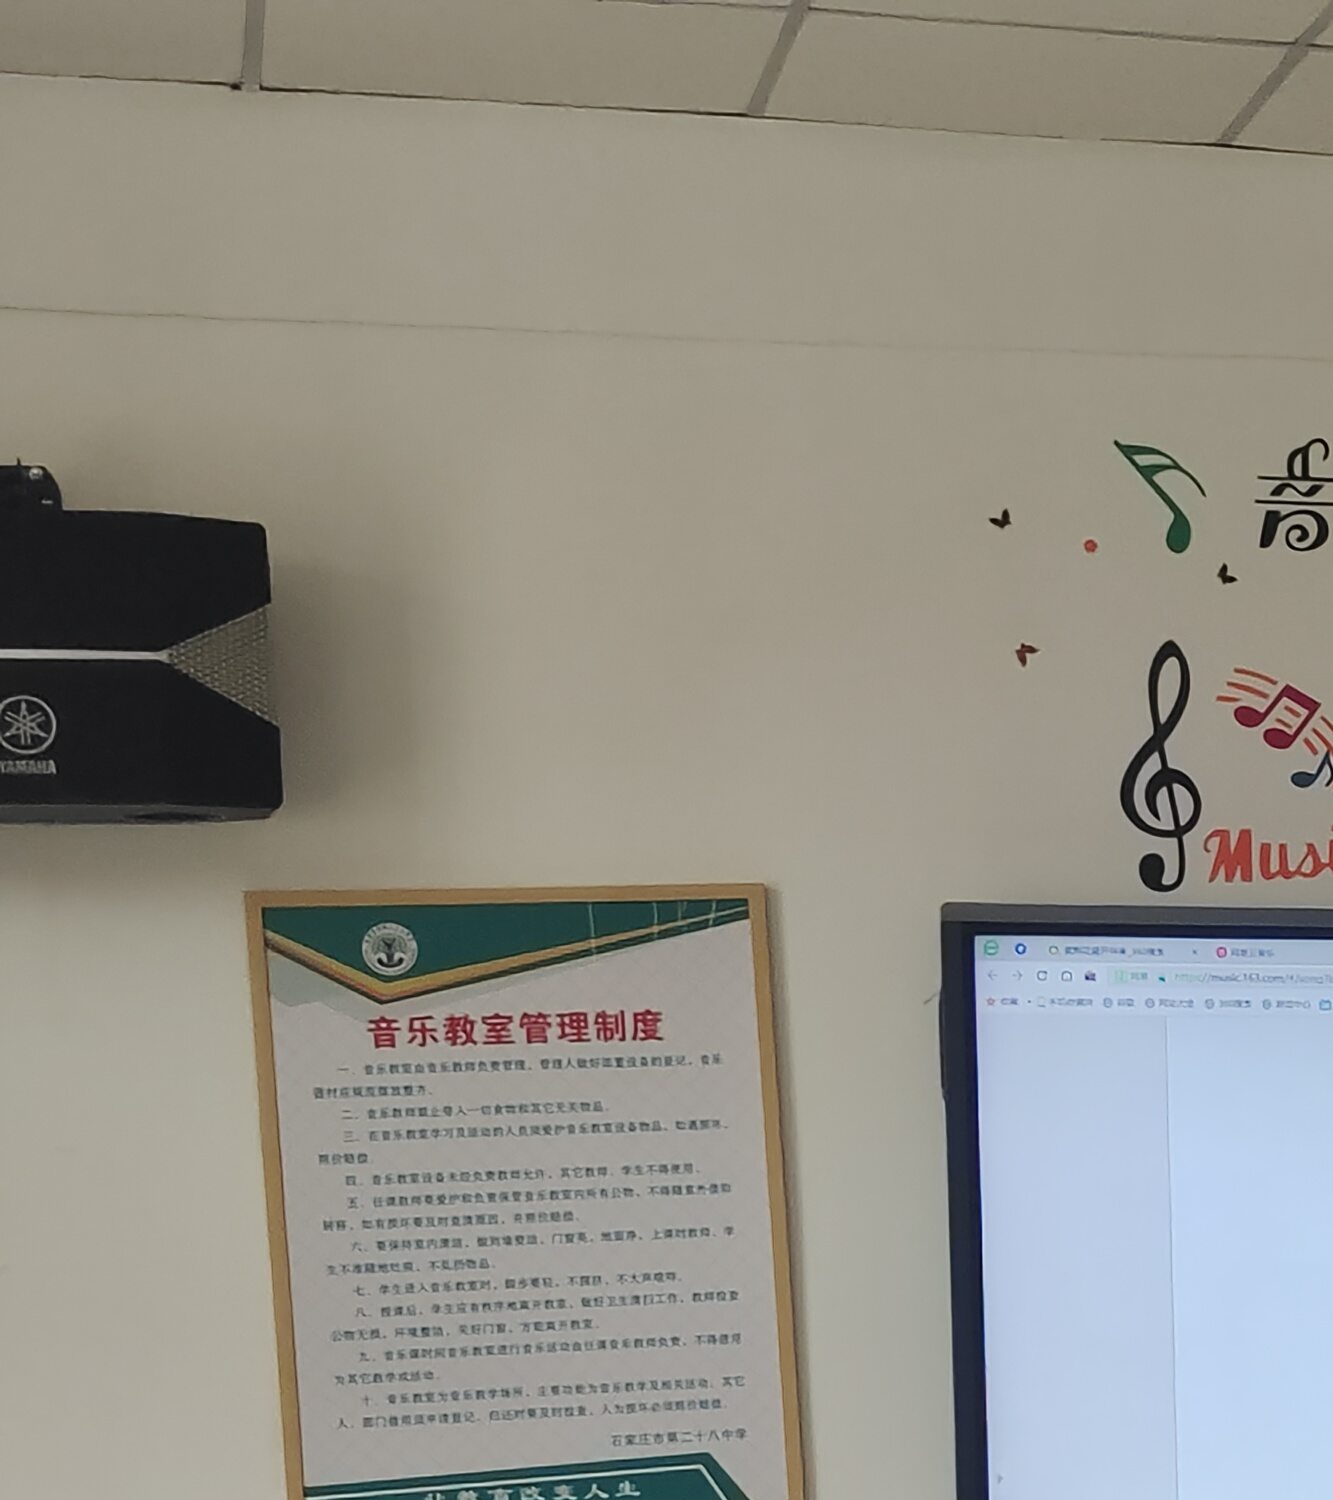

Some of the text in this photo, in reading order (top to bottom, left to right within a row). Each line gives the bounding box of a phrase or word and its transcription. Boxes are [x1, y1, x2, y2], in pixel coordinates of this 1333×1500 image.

[366, 1009, 665, 1049] 音乐教室管理制度
[611, 1428, 748, 1447] 石家庄市第二十八中学
